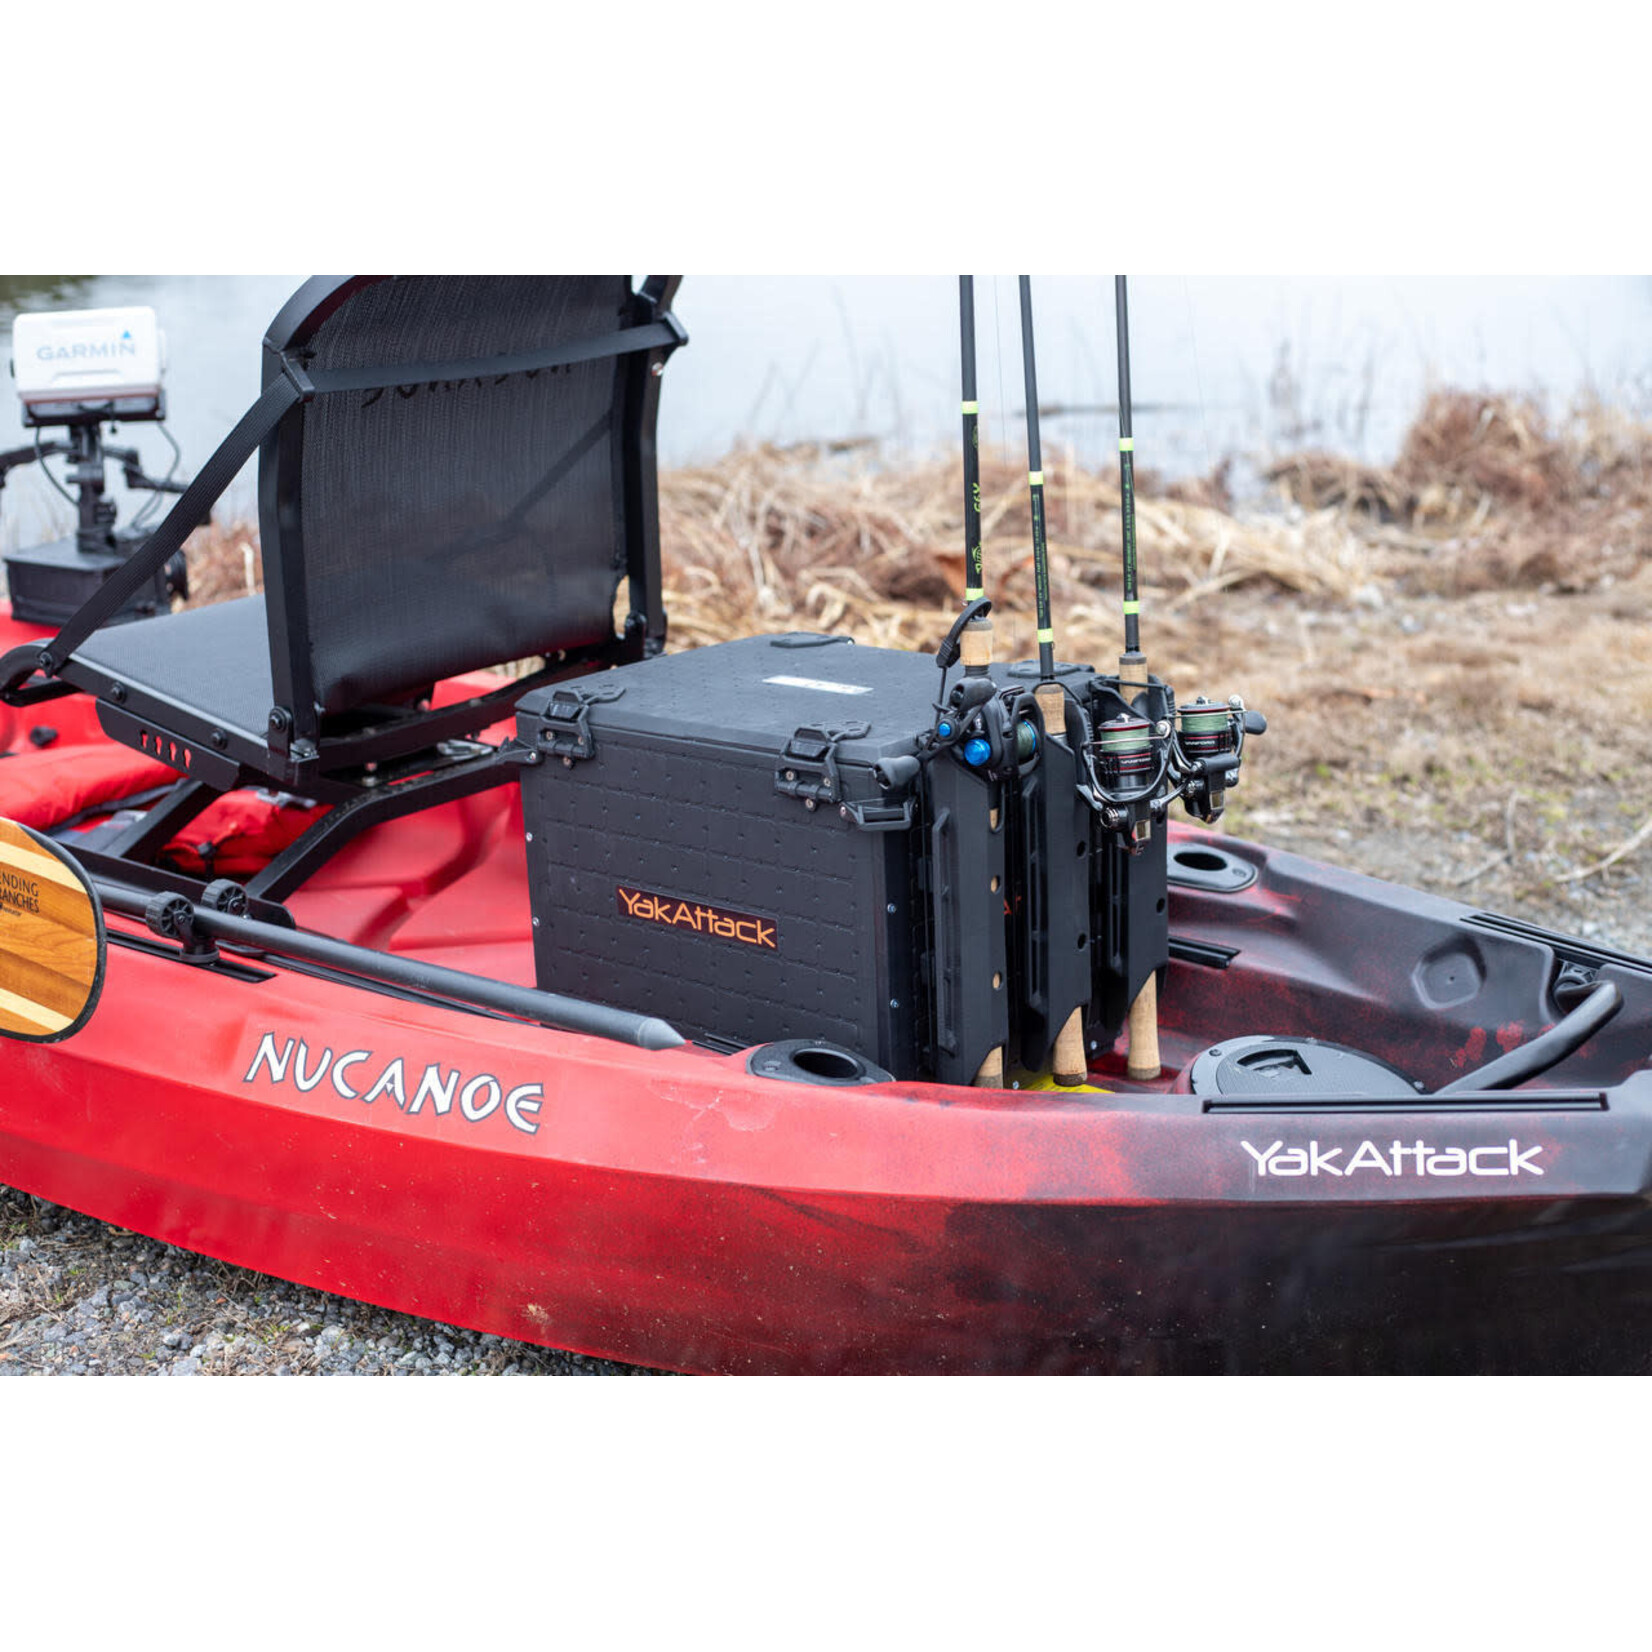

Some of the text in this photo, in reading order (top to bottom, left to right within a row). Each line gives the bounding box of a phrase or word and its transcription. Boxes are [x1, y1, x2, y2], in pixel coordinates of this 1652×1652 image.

[36, 341, 137, 361] GARMIN
[618, 888, 776, 948] YakAttack
[243, 1031, 545, 1135] NUCANOE
[1240, 1138, 1545, 1177] YakAttack
